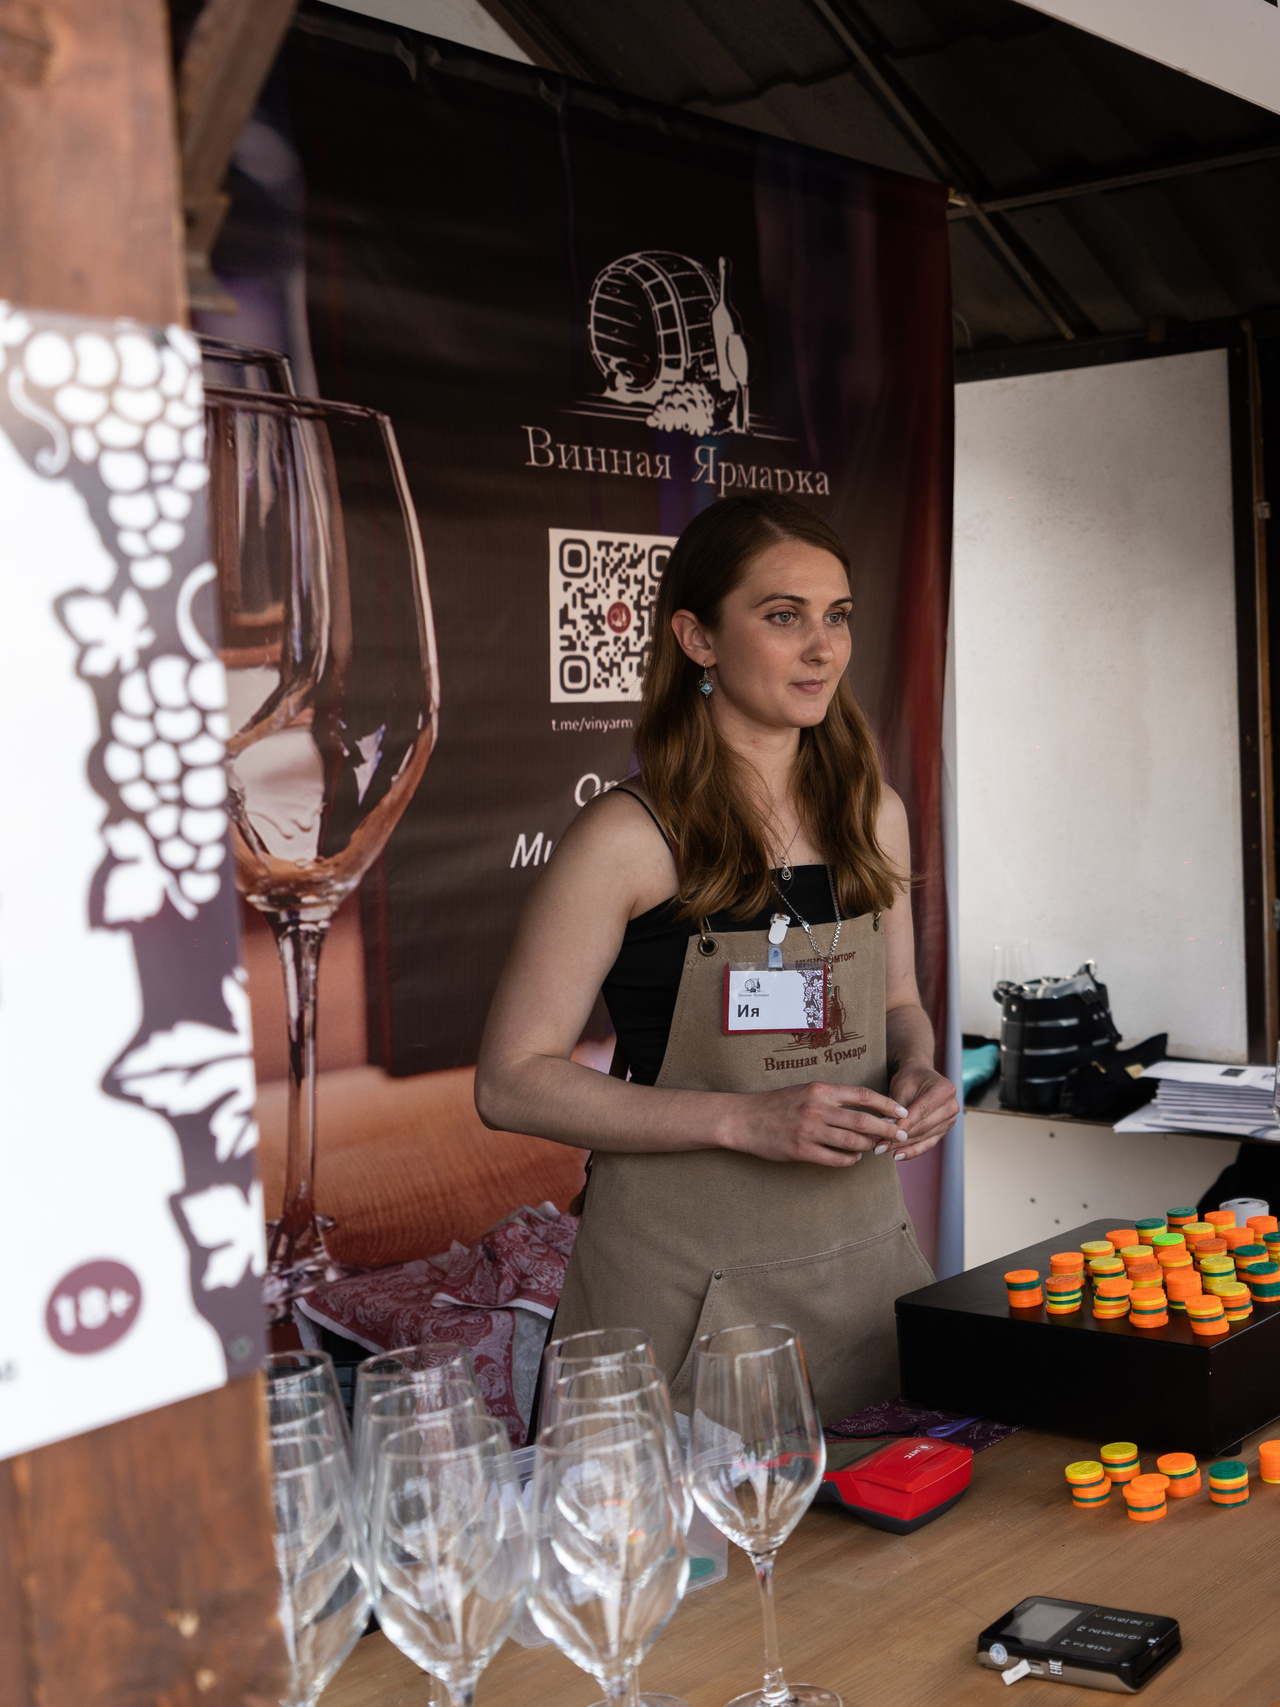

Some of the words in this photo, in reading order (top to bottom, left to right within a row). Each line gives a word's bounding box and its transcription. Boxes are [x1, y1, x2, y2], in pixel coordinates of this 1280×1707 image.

[521, 425, 672, 480] Винная
[690, 445, 830, 498] Ярмарка
[737, 1004, 760, 1018] Ия
[763, 1057, 818, 1071] Винная
